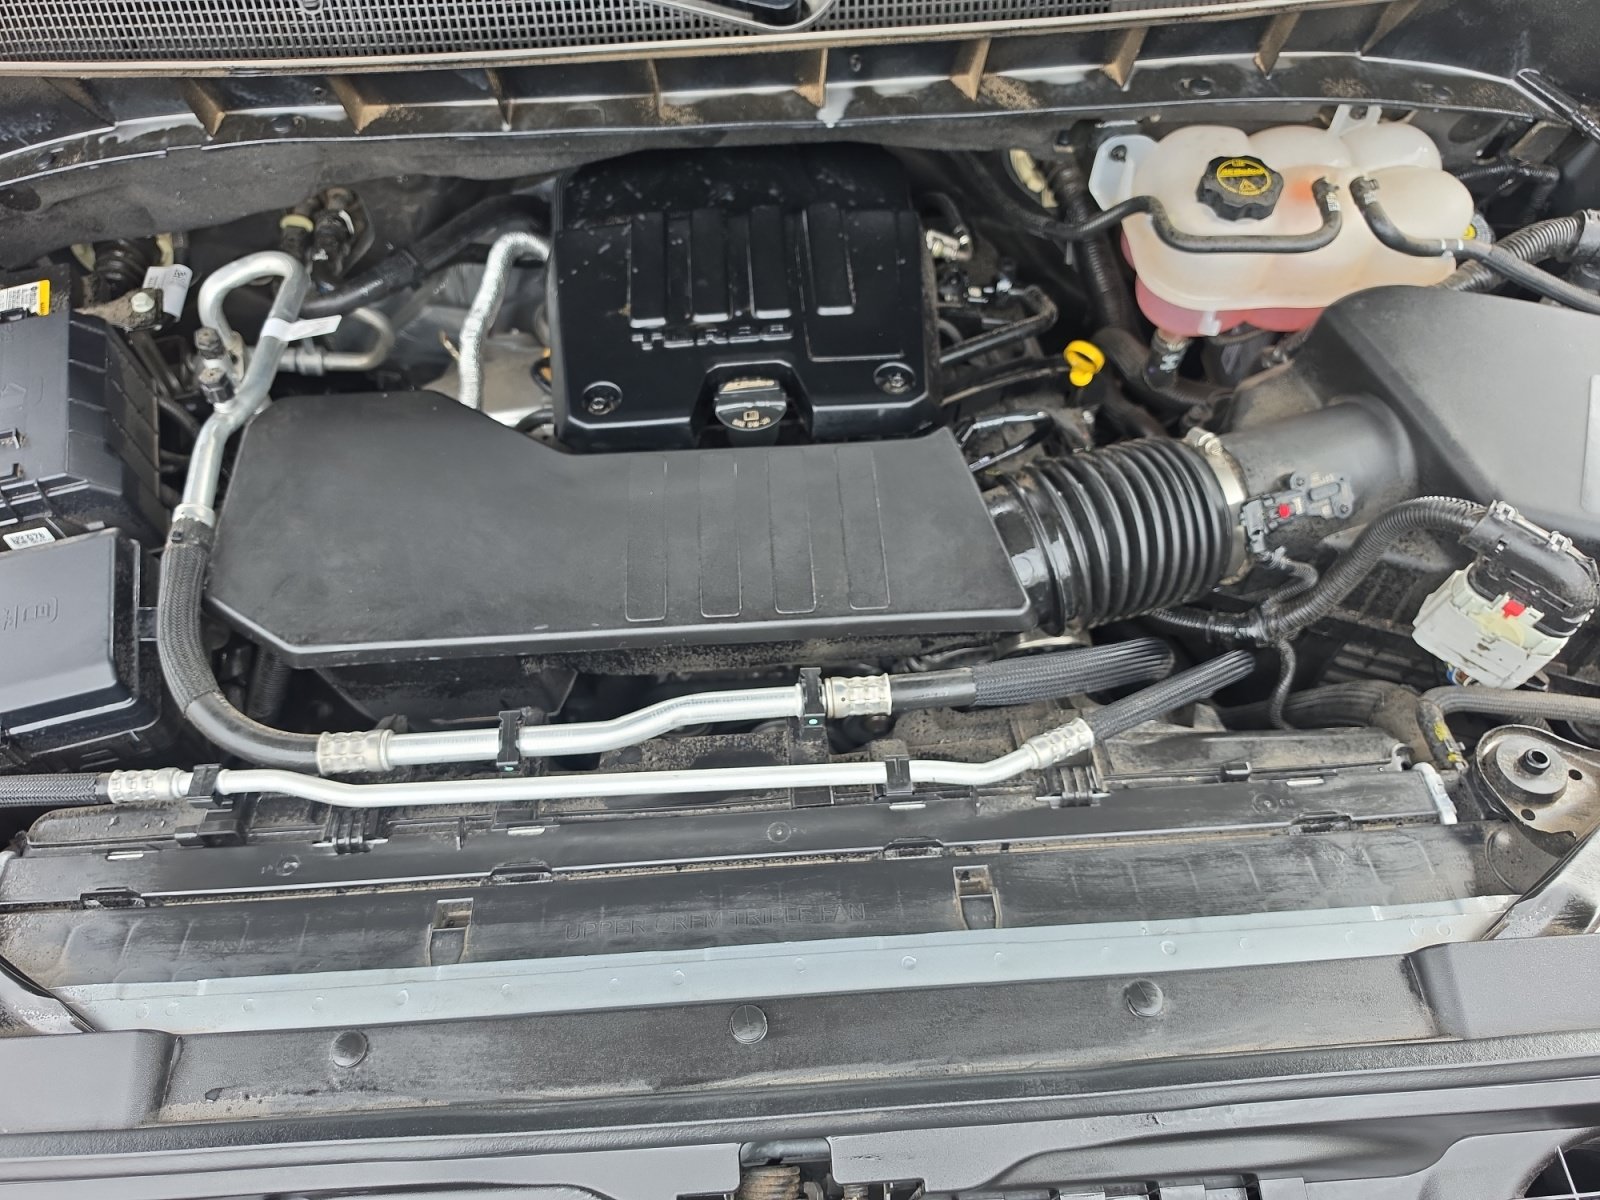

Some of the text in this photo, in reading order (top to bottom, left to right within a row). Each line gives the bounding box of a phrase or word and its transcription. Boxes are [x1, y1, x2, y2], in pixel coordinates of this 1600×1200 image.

[565, 917, 648, 942] UPPER
[728, 905, 813, 925] TRIPLE
[820, 903, 866, 922] FAN
